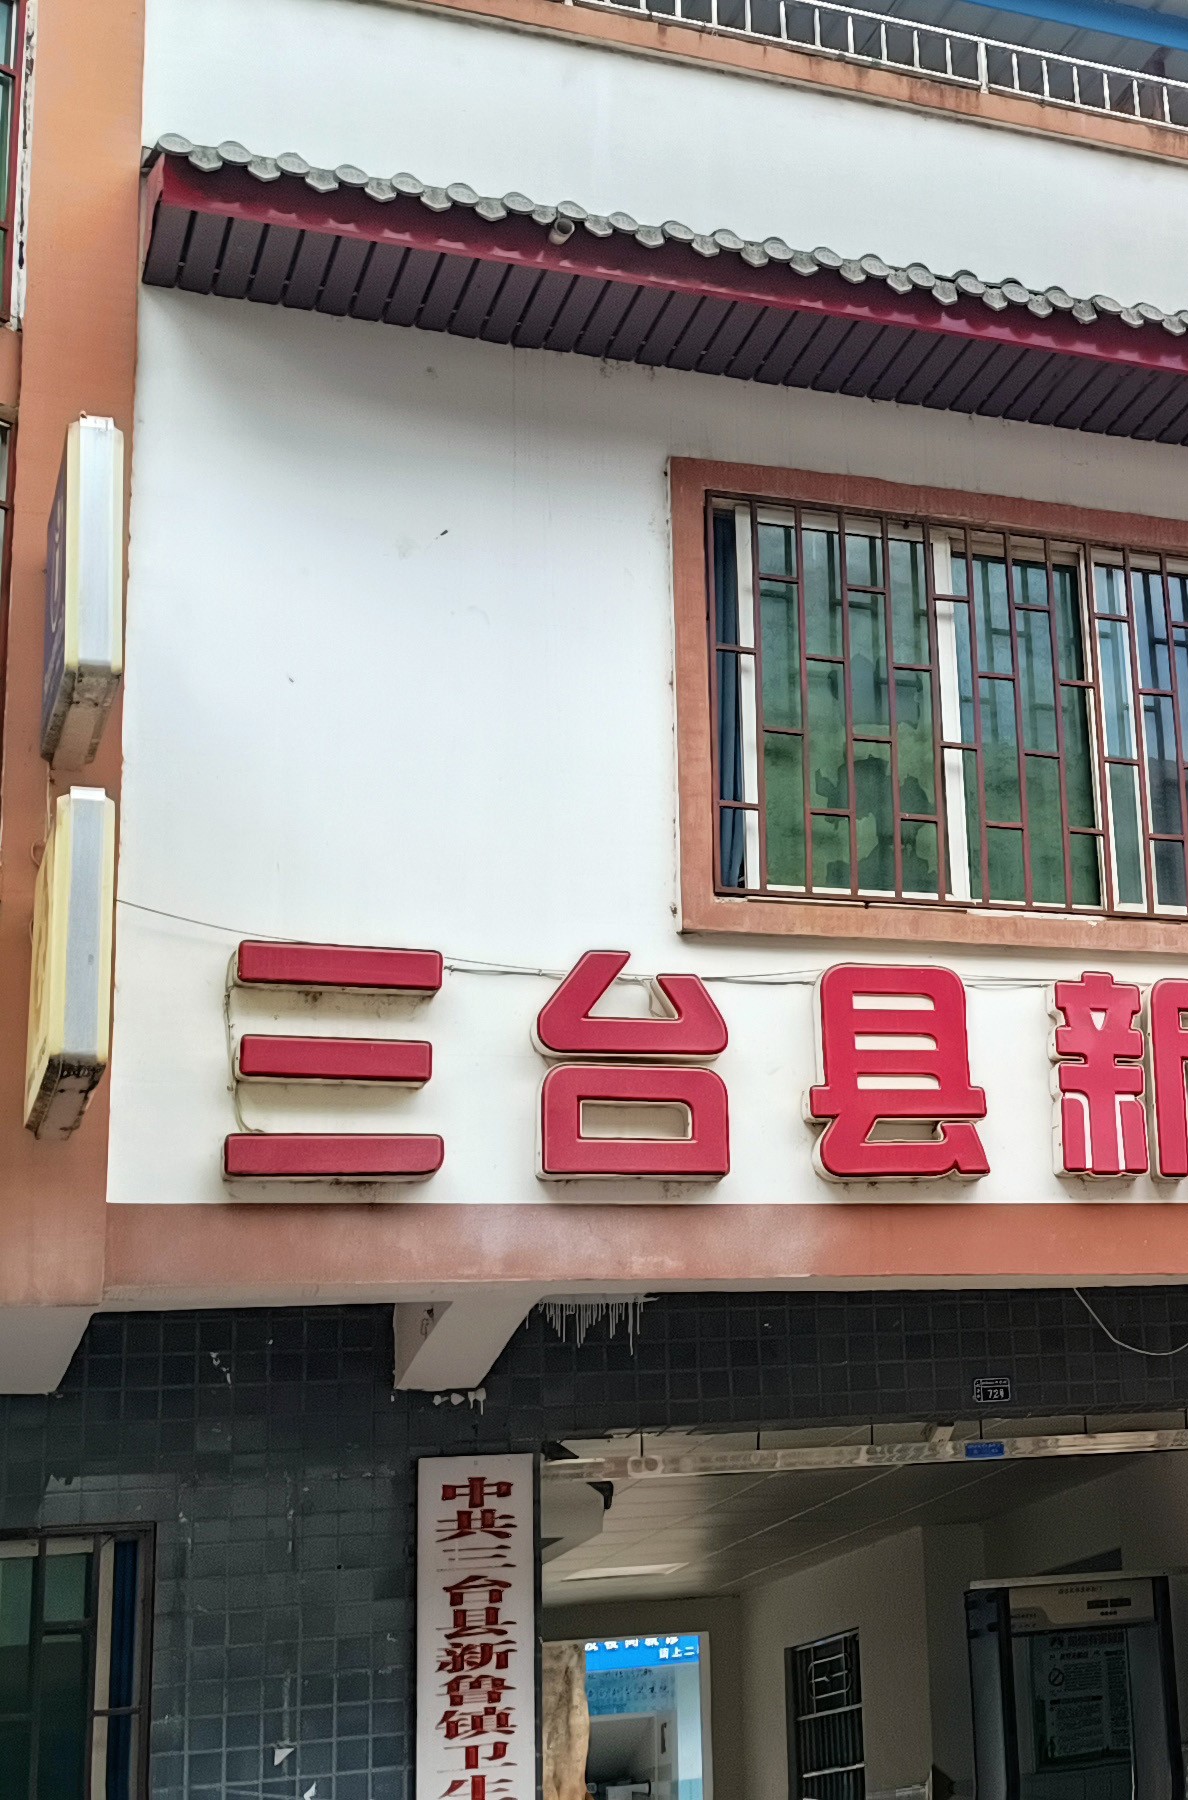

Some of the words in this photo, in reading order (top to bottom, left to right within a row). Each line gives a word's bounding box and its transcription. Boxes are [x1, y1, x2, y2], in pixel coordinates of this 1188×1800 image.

[436, 1476, 518, 1800] 中共三台县新鲁镇卫生
